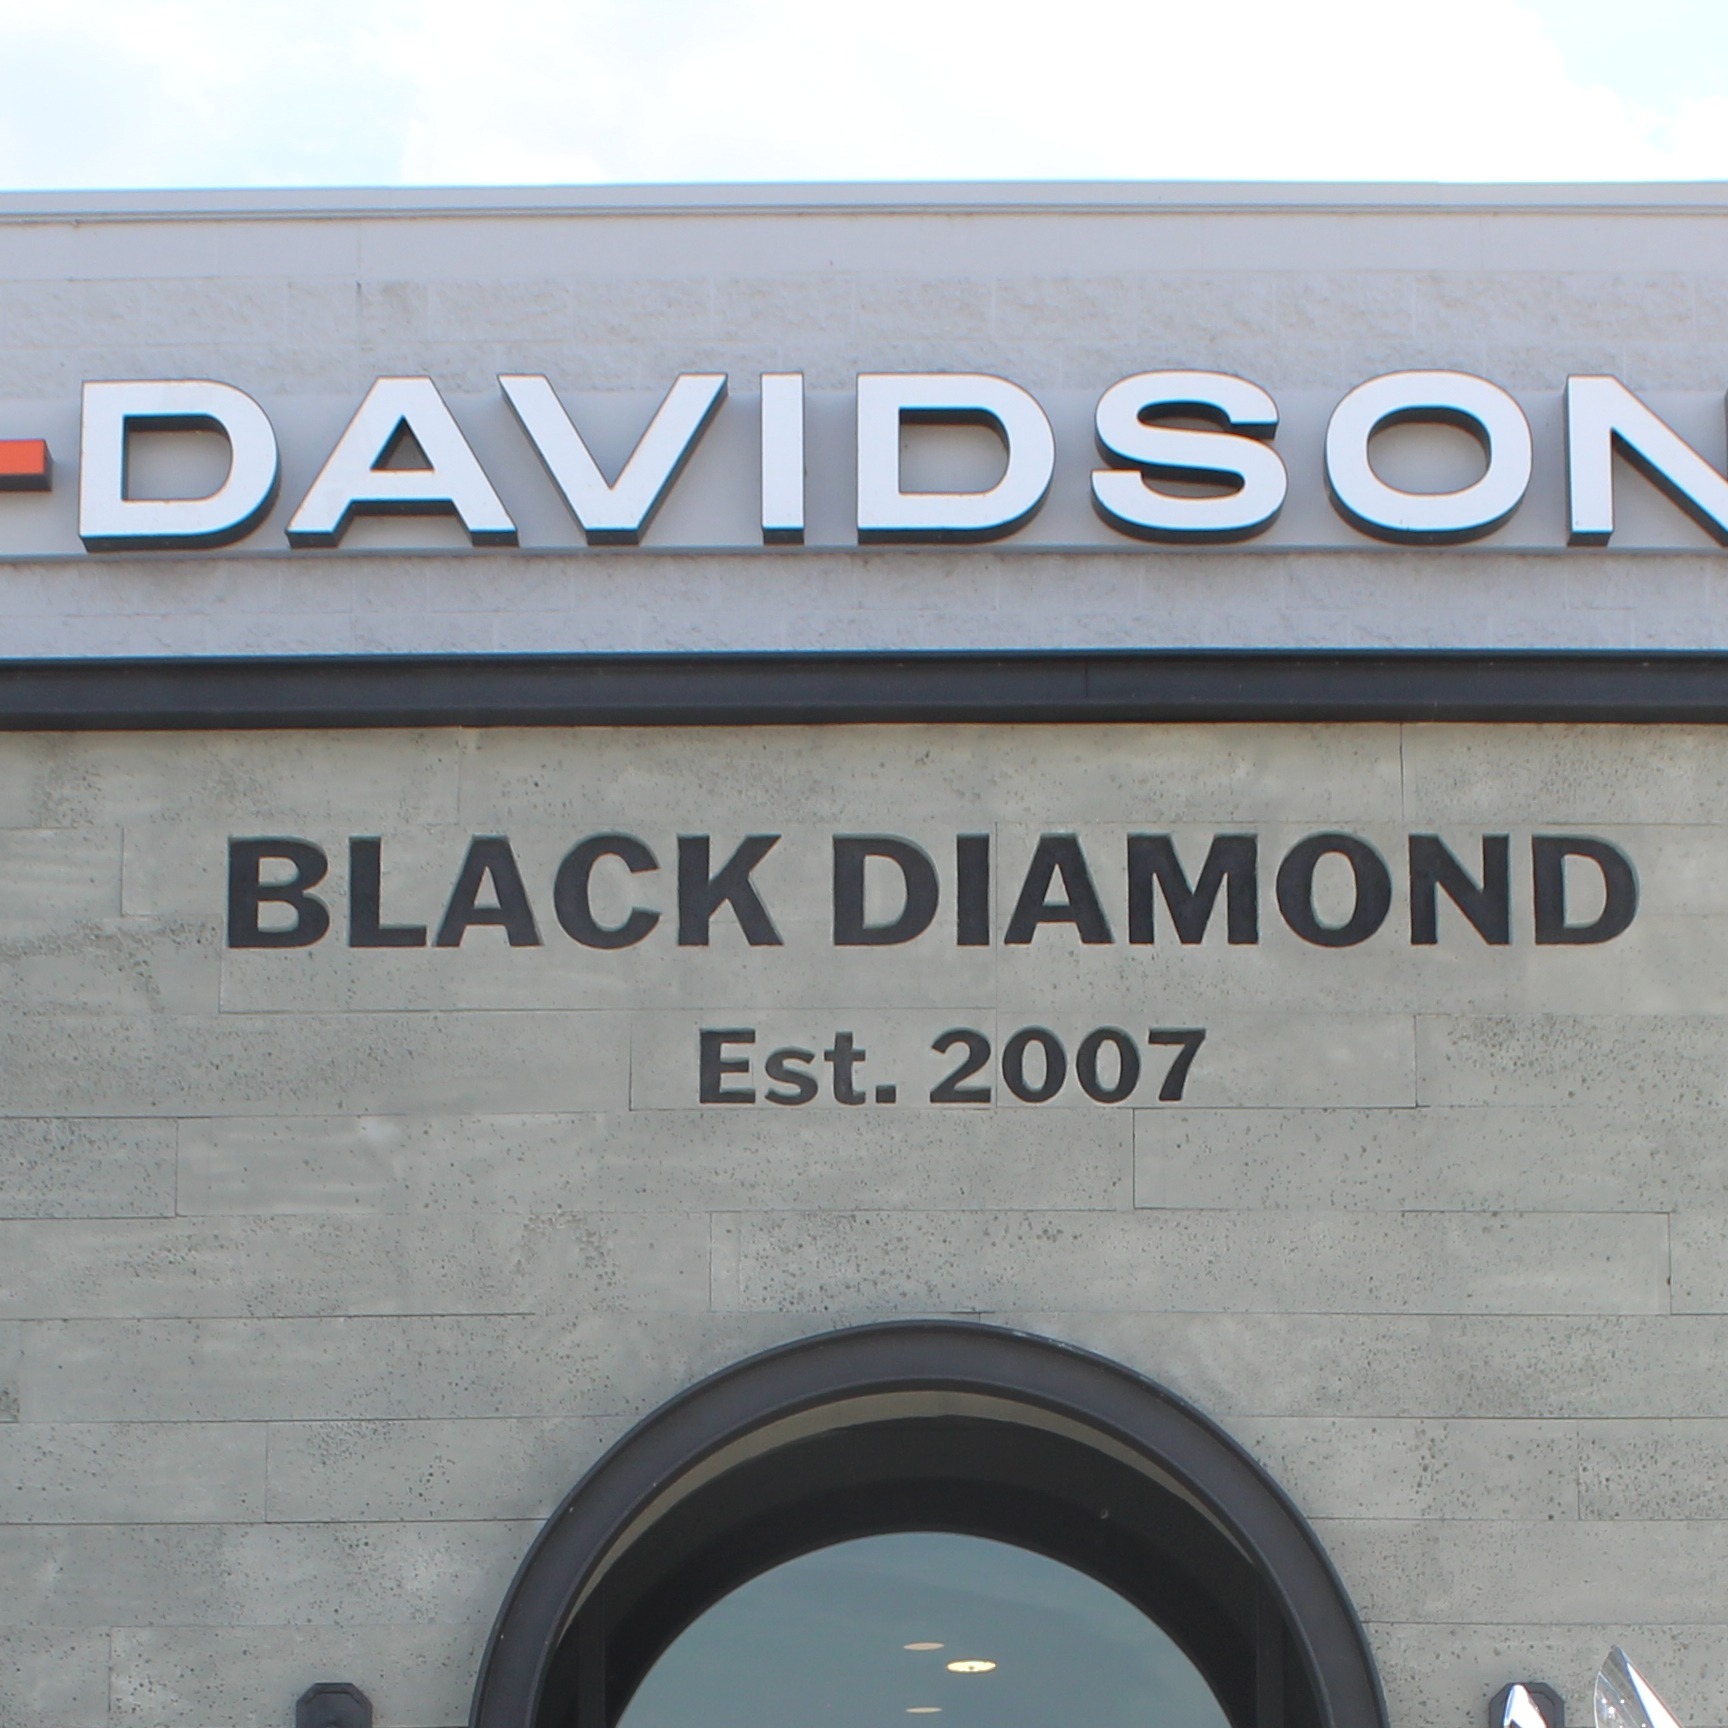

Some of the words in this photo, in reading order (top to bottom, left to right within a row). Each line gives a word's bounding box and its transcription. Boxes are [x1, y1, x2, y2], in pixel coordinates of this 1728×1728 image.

[227, 833, 784, 949] BLACK
[832, 833, 1641, 948] DIAMOND
[699, 1026, 898, 1104] Est.
[928, 1026, 1208, 1104] 2007
